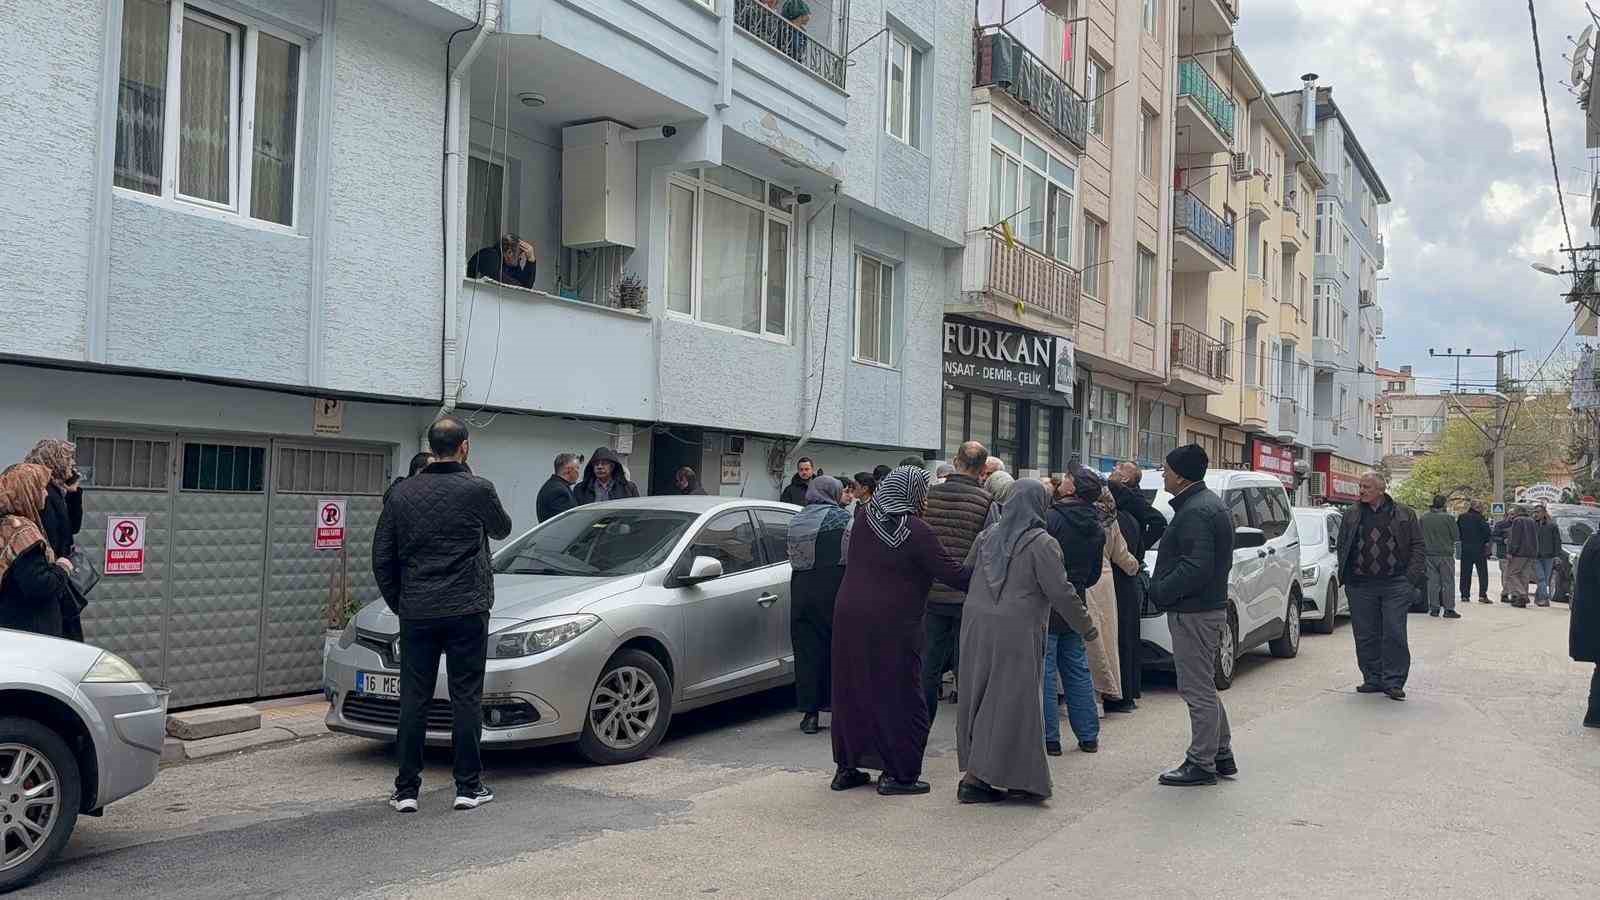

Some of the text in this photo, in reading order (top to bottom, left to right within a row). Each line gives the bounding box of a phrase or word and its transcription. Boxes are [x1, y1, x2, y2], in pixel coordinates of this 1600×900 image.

[943, 322, 1052, 367] FURKAN
[983, 366, 1013, 382] DEMİR
[1018, 370, 1042, 387] ÇELİK
[366, 675, 376, 691] 16
